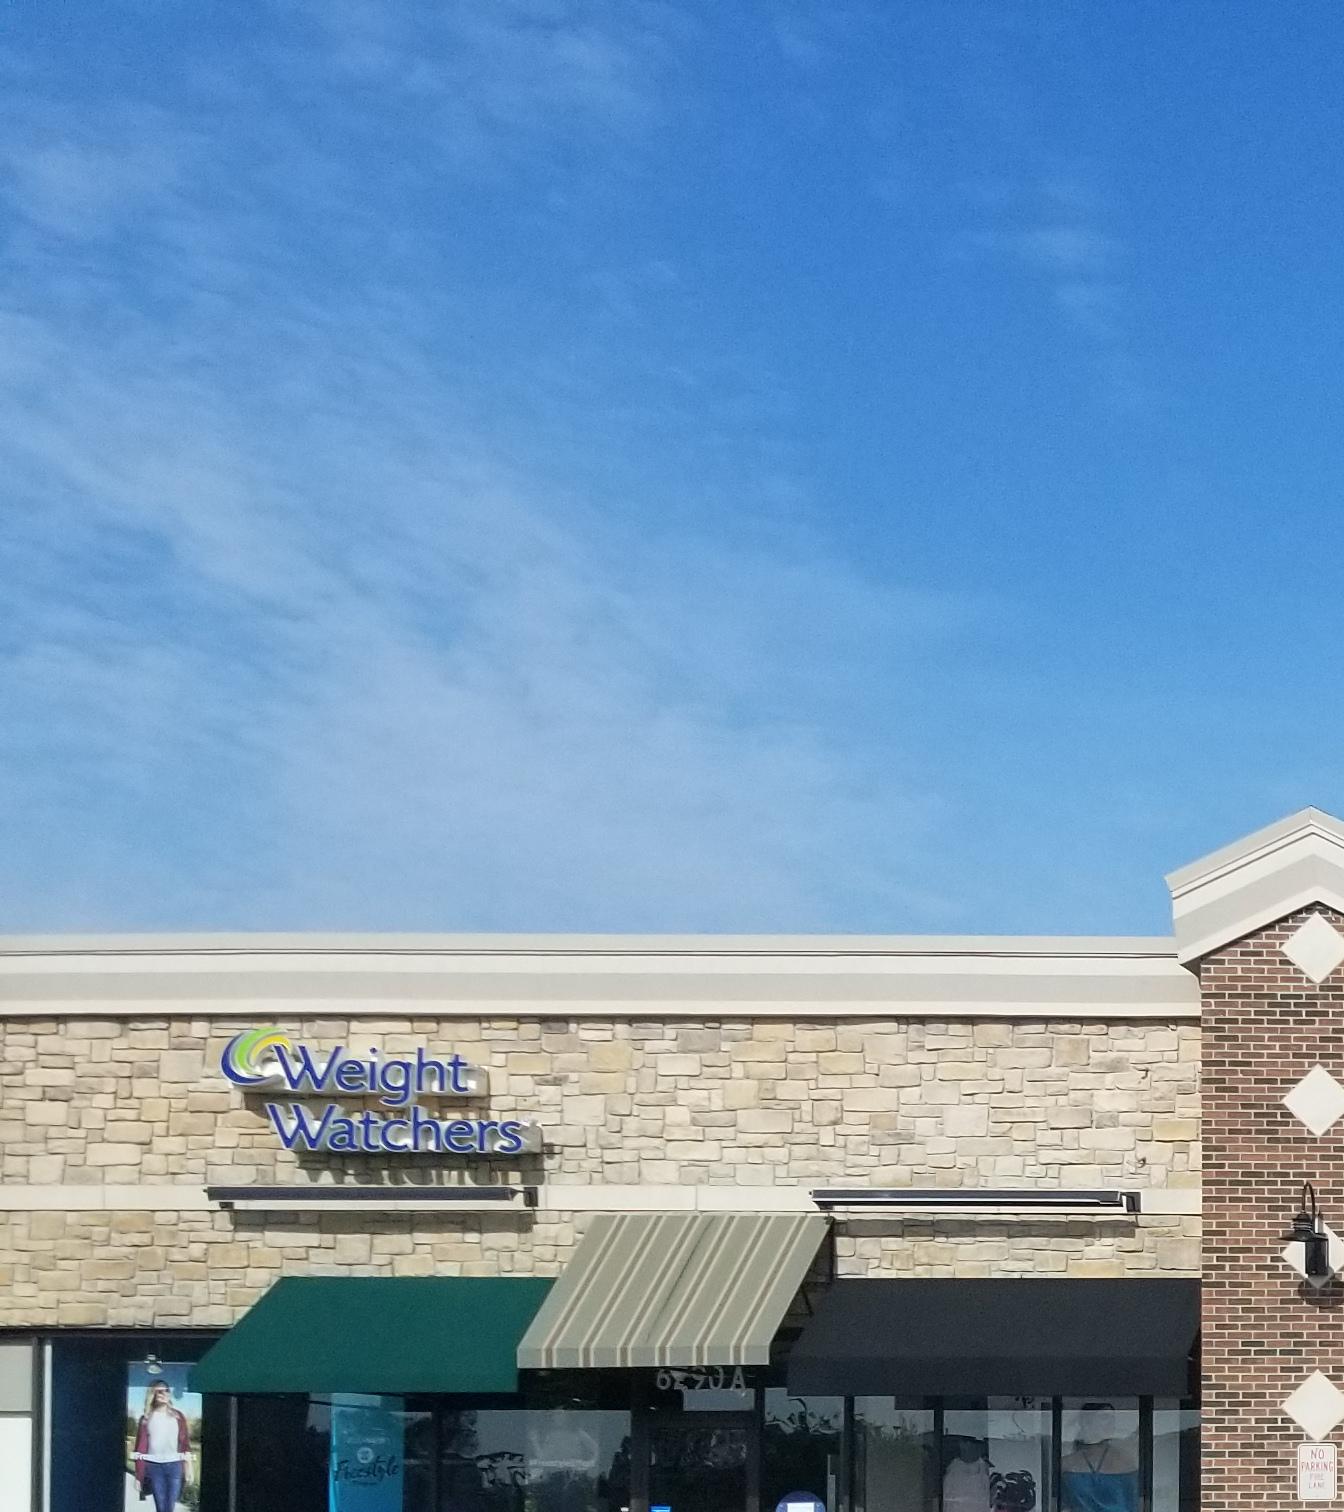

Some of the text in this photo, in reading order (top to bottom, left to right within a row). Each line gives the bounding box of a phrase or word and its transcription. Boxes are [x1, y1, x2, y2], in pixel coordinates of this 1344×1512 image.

[271, 1045, 472, 1106] Weight
[265, 1103, 524, 1153] Watchers
[1301, 1462, 1334, 1472] PARKING
[1310, 1450, 1325, 1460] NO
